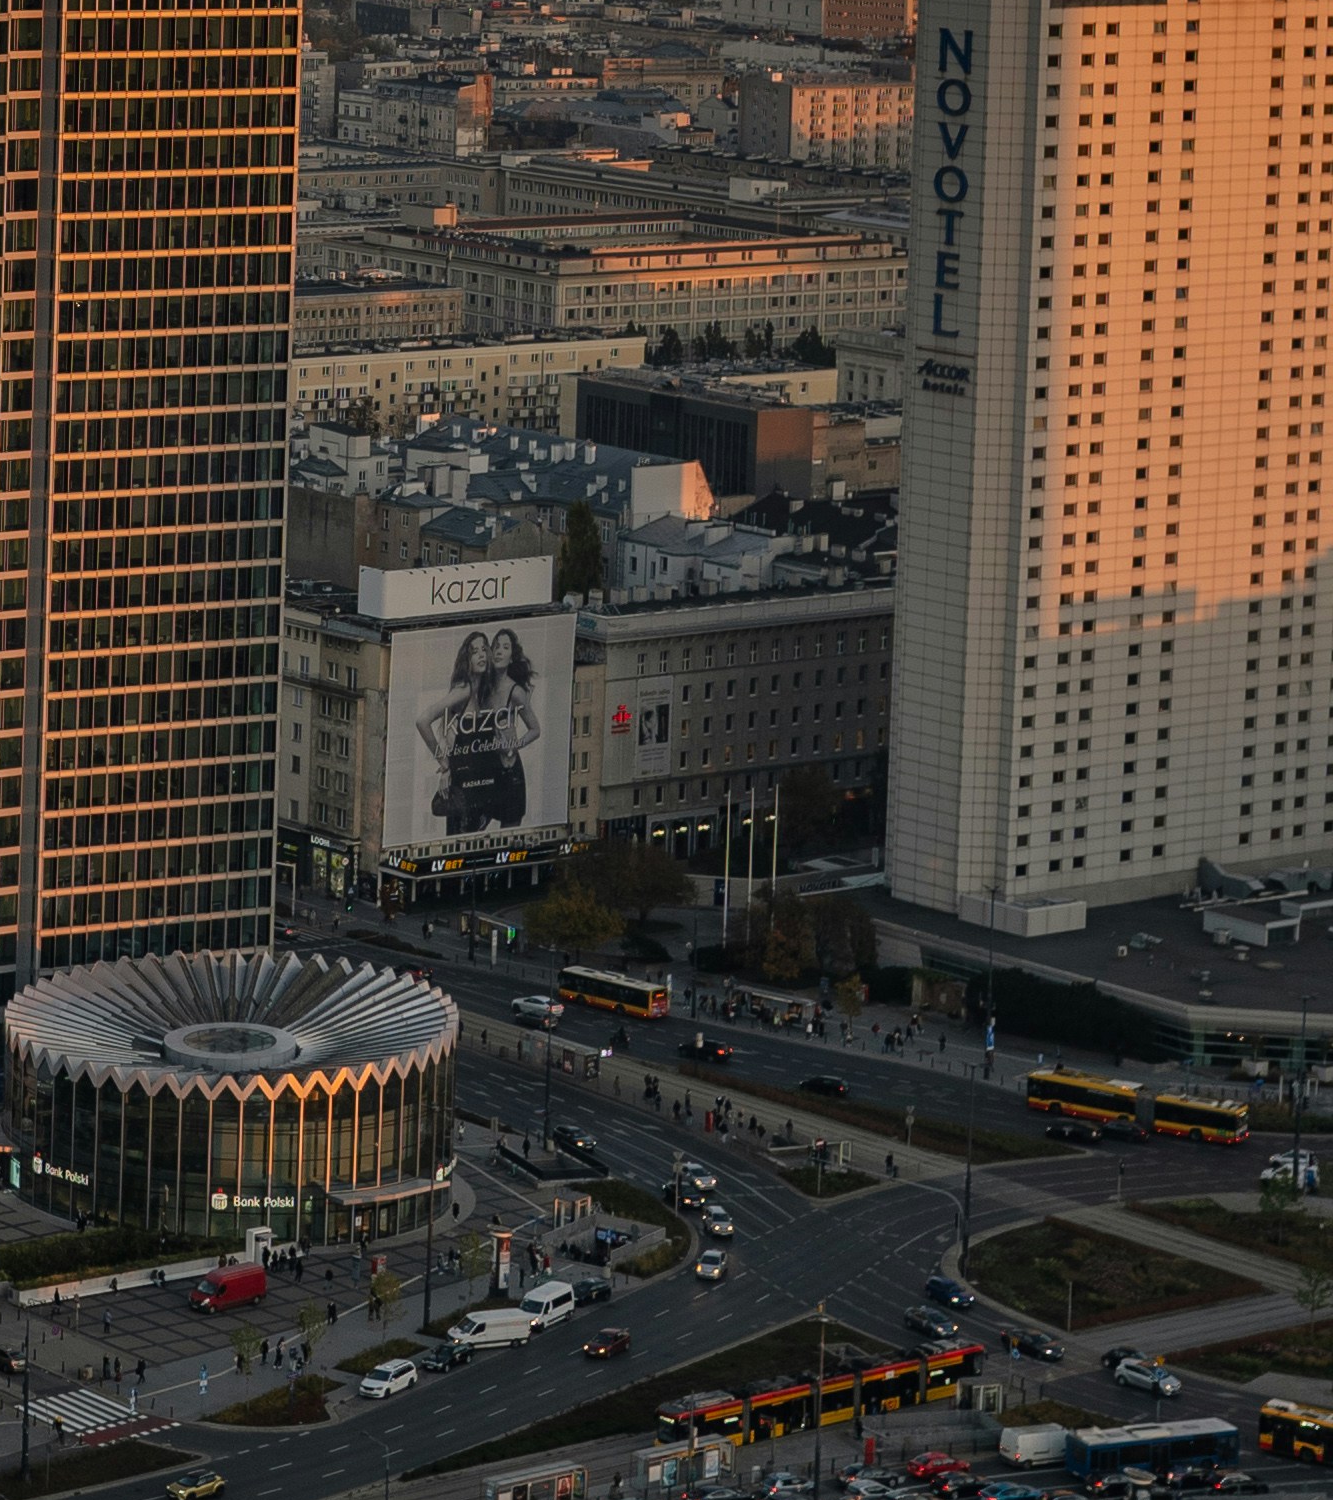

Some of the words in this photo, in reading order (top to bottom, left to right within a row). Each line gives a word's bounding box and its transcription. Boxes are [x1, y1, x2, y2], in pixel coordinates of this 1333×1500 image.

[933, 27, 973, 338] NOVOTEL
[431, 574, 512, 606] kazar
[443, 704, 524, 736] kazar
[470, 736, 526, 754] Celebration
[234, 1195, 260, 1208] Bank
[264, 1196, 294, 1208] Polski
